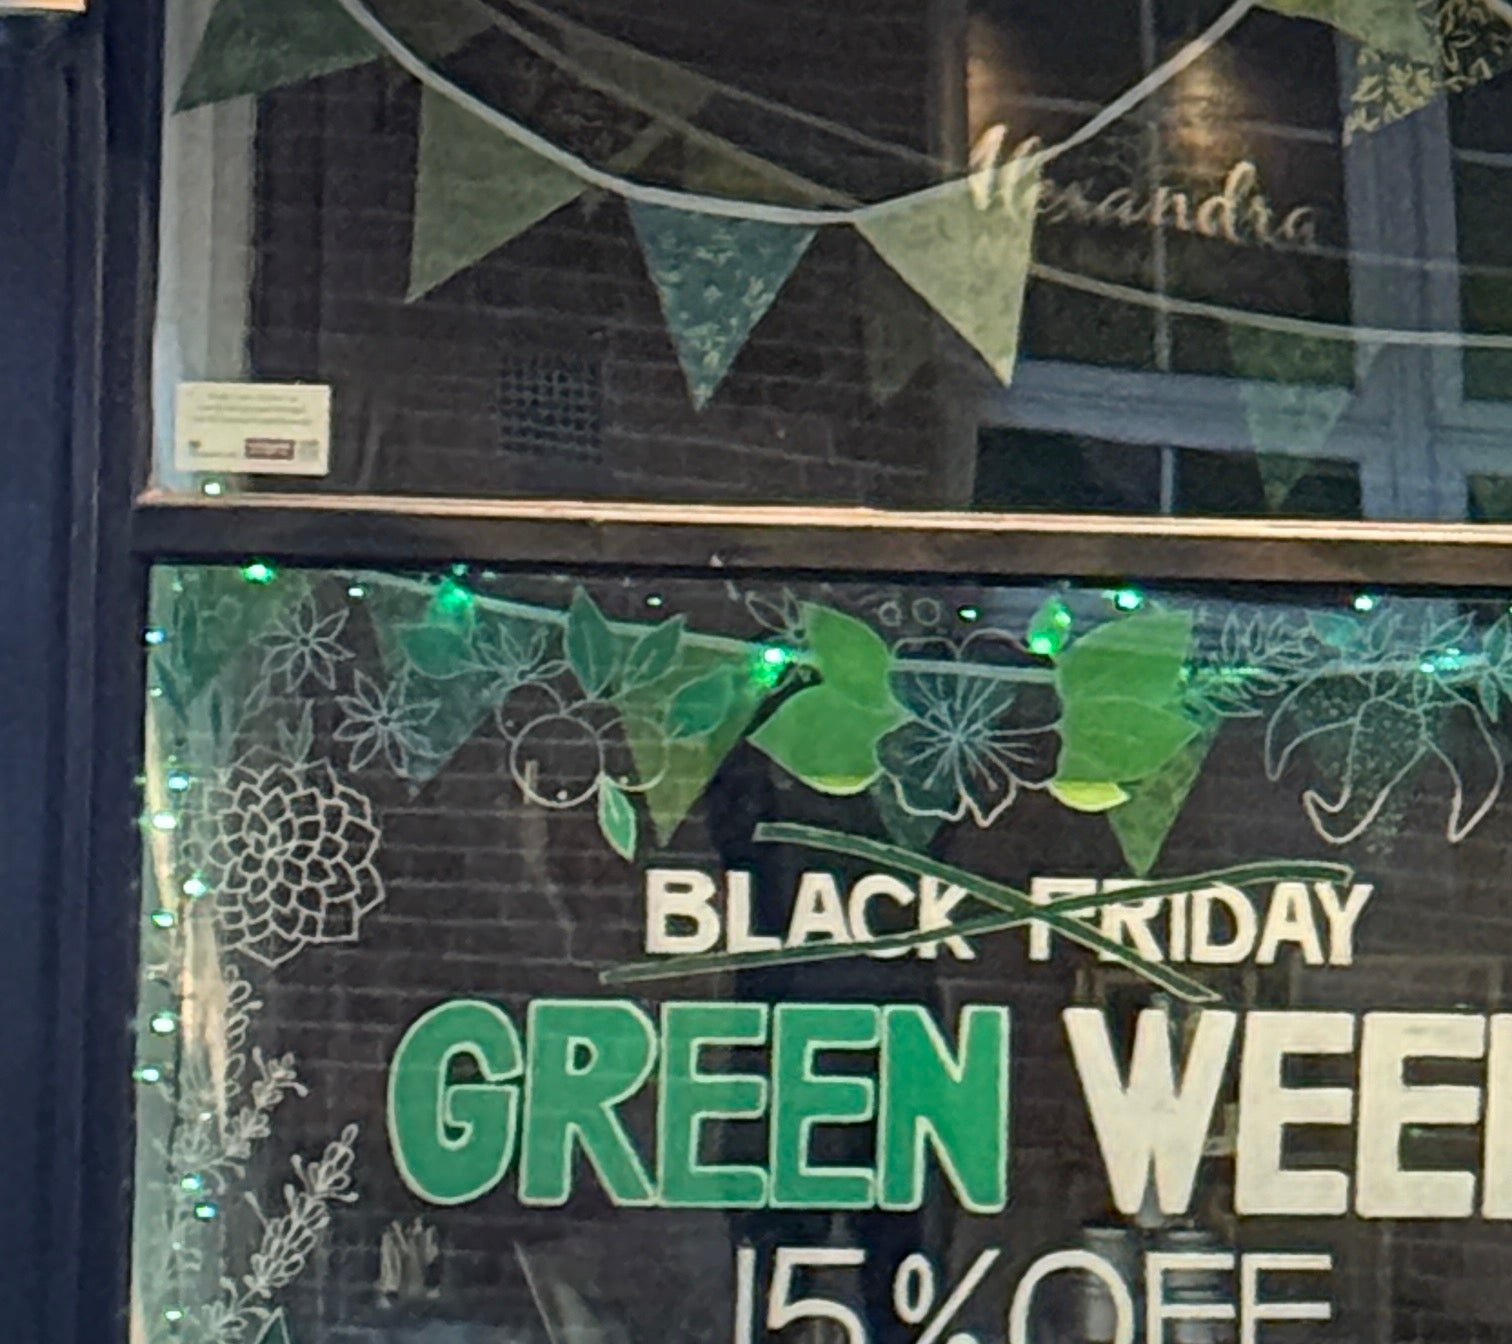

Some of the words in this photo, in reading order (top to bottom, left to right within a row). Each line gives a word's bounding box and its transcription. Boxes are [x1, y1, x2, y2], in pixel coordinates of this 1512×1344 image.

[645, 869, 977, 960] BLACK
[1028, 876, 1374, 967] FRIDAY
[386, 999, 1011, 1217] GREEN
